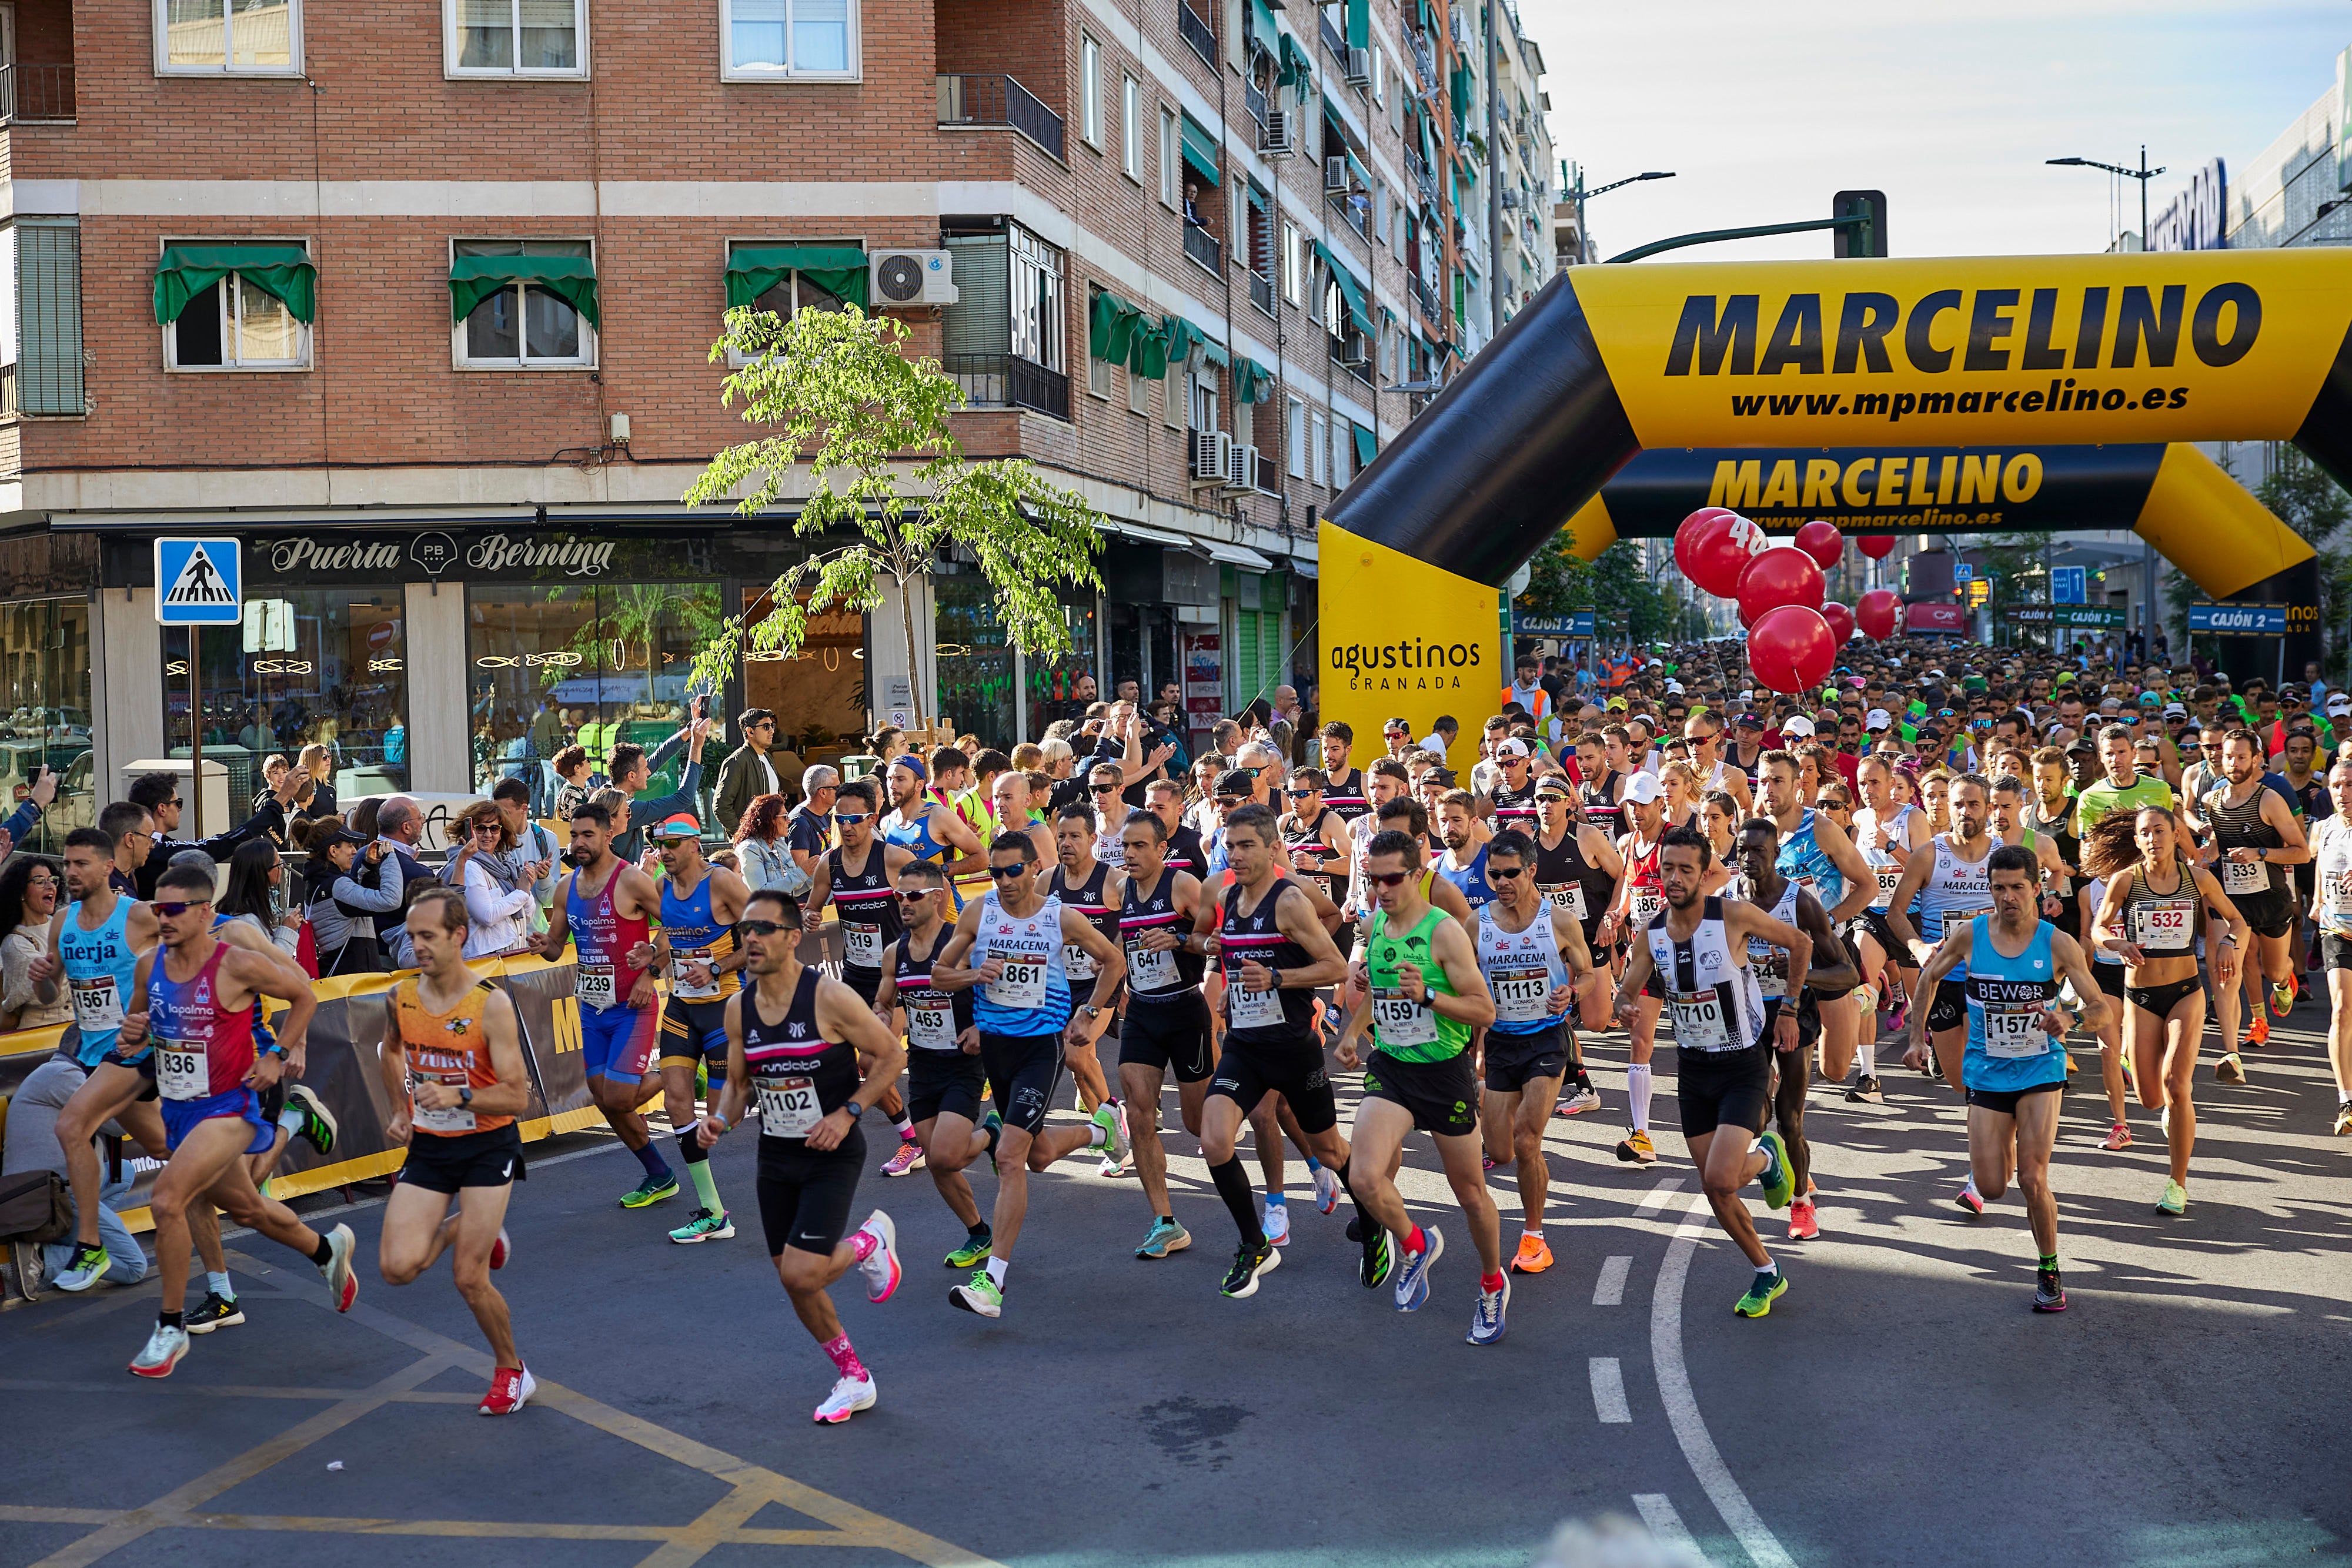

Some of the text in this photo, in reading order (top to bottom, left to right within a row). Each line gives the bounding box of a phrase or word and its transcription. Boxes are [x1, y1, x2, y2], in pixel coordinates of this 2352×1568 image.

[1663, 282, 2263, 377] MARCELINO
[1732, 378, 2190, 422] www.mpmarcelino.es
[1707, 452, 2043, 508] MARCELINO
[1746, 508, 2003, 530] wwwmpmarcelino.es
[272, 536, 401, 573] Puerta
[424, 545, 444, 555] PB
[466, 533, 616, 576] Bernina
[804, 610, 863, 636] uerta
[1565, 617, 1575, 631] 2
[2071, 610, 2103, 623] CAJÓN
[2104, 614, 2112, 623] 3
[2211, 610, 2253, 627] CAJÓN
[2256, 614, 2266, 628] 2
[1332, 637, 1480, 678] agustinos
[1351, 676, 1461, 690] GRANADA
[1541, 780, 1569, 793] ESSPORT
[1779, 862, 1811, 876] ADIX
[2233, 863, 2257, 877] 533
[1879, 875, 1896, 888] 86
[2332, 881, 2352, 895] 15
[1465, 896, 1485, 905] ERRA
[1551, 891, 1575, 906] 198
[580, 917, 616, 928] lapalma
[2152, 912, 2183, 928] 532
[850, 932, 873, 948] 519
[988, 938, 1050, 951] MARACENA
[64, 941, 117, 964] nerja
[1067, 947, 1085, 961] 14
[1137, 952, 1161, 968] 647
[1488, 952, 1546, 965] MARACENA
[1753, 966, 1773, 979] 84
[582, 976, 610, 992] 1239
[1502, 980, 1544, 999] 1113
[76, 989, 112, 1009] 1567
[168, 1003, 214, 1017] lapalma
[1380, 1001, 1424, 1021] 1597
[1676, 1003, 1716, 1022] 1710
[552, 995, 583, 1054] M
[916, 1011, 944, 1028] 463
[1995, 1013, 2040, 1034] 1574
[419, 1044, 463, 1057] Deportivo
[164, 1053, 195, 1074] 836
[766, 1091, 812, 1111] 1102
